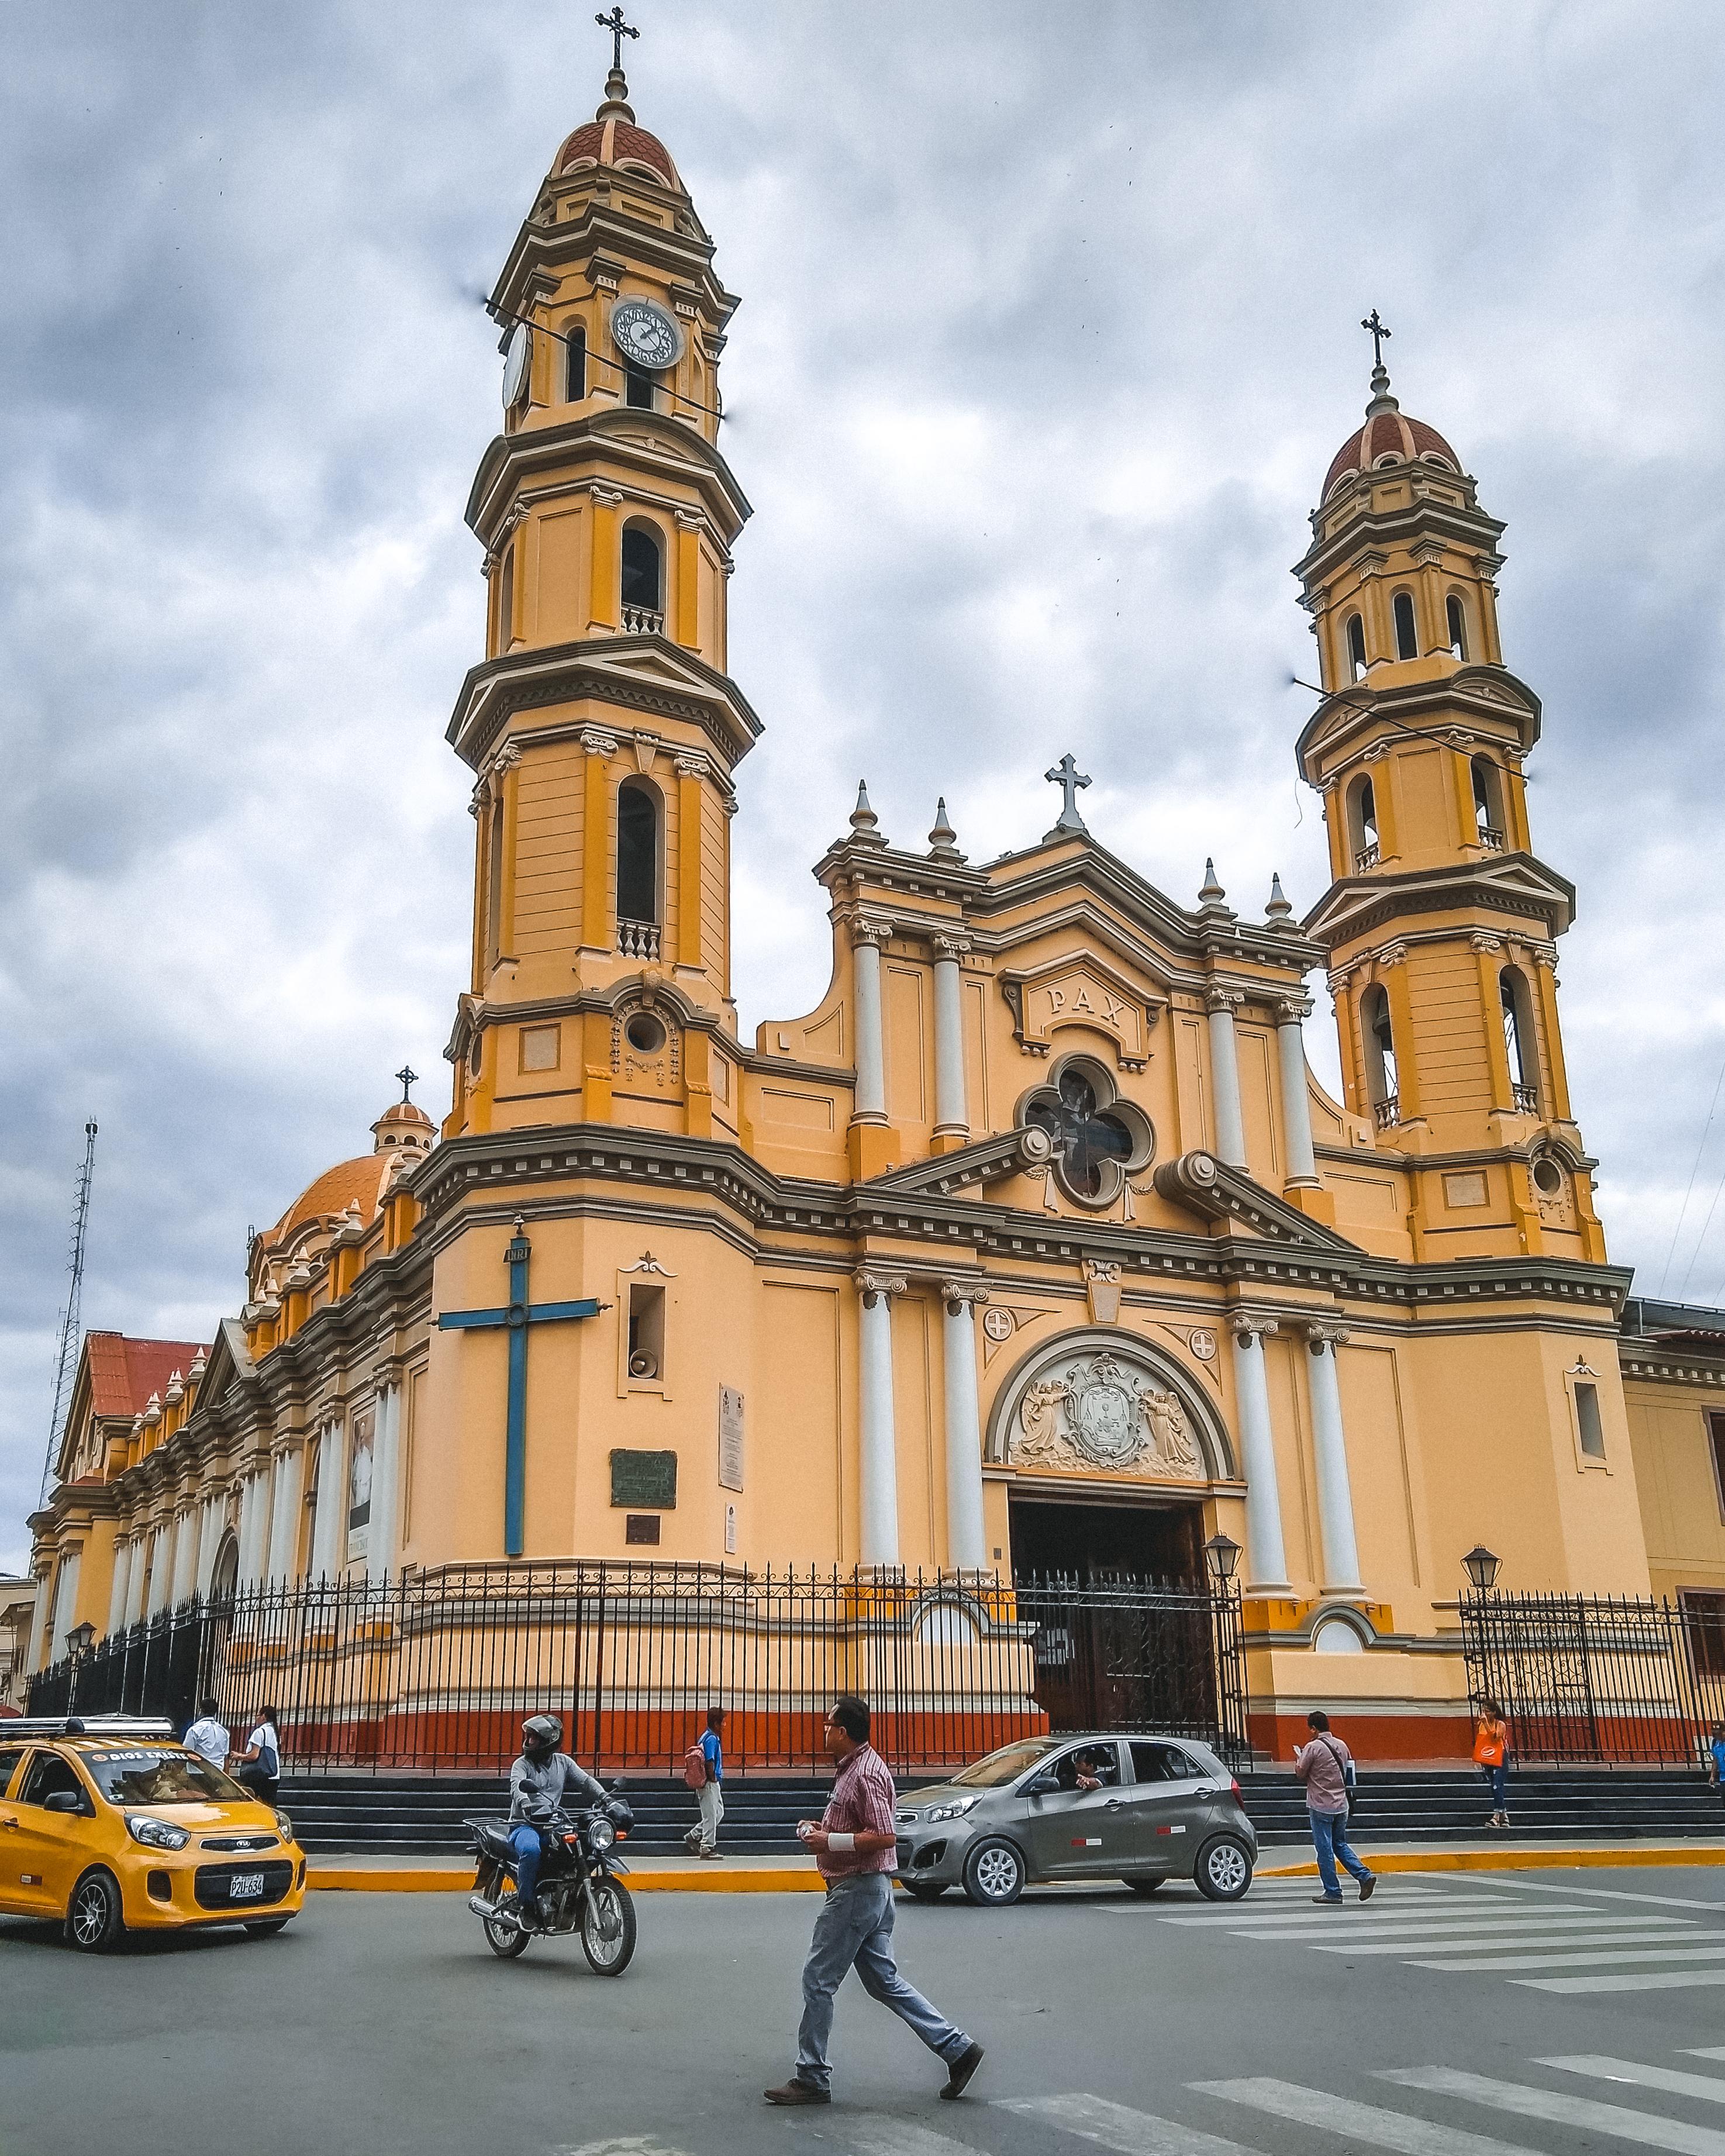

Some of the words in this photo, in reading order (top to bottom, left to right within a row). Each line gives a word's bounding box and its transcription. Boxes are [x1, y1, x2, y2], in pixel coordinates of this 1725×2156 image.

[1047, 988, 1124, 1028] PAX
[508, 1248, 527, 1260] INRI
[109, 1752, 143, 1761] DIOS
[146, 1751, 188, 1760] EXISTE
[232, 1880, 262, 1895] P2U-634
